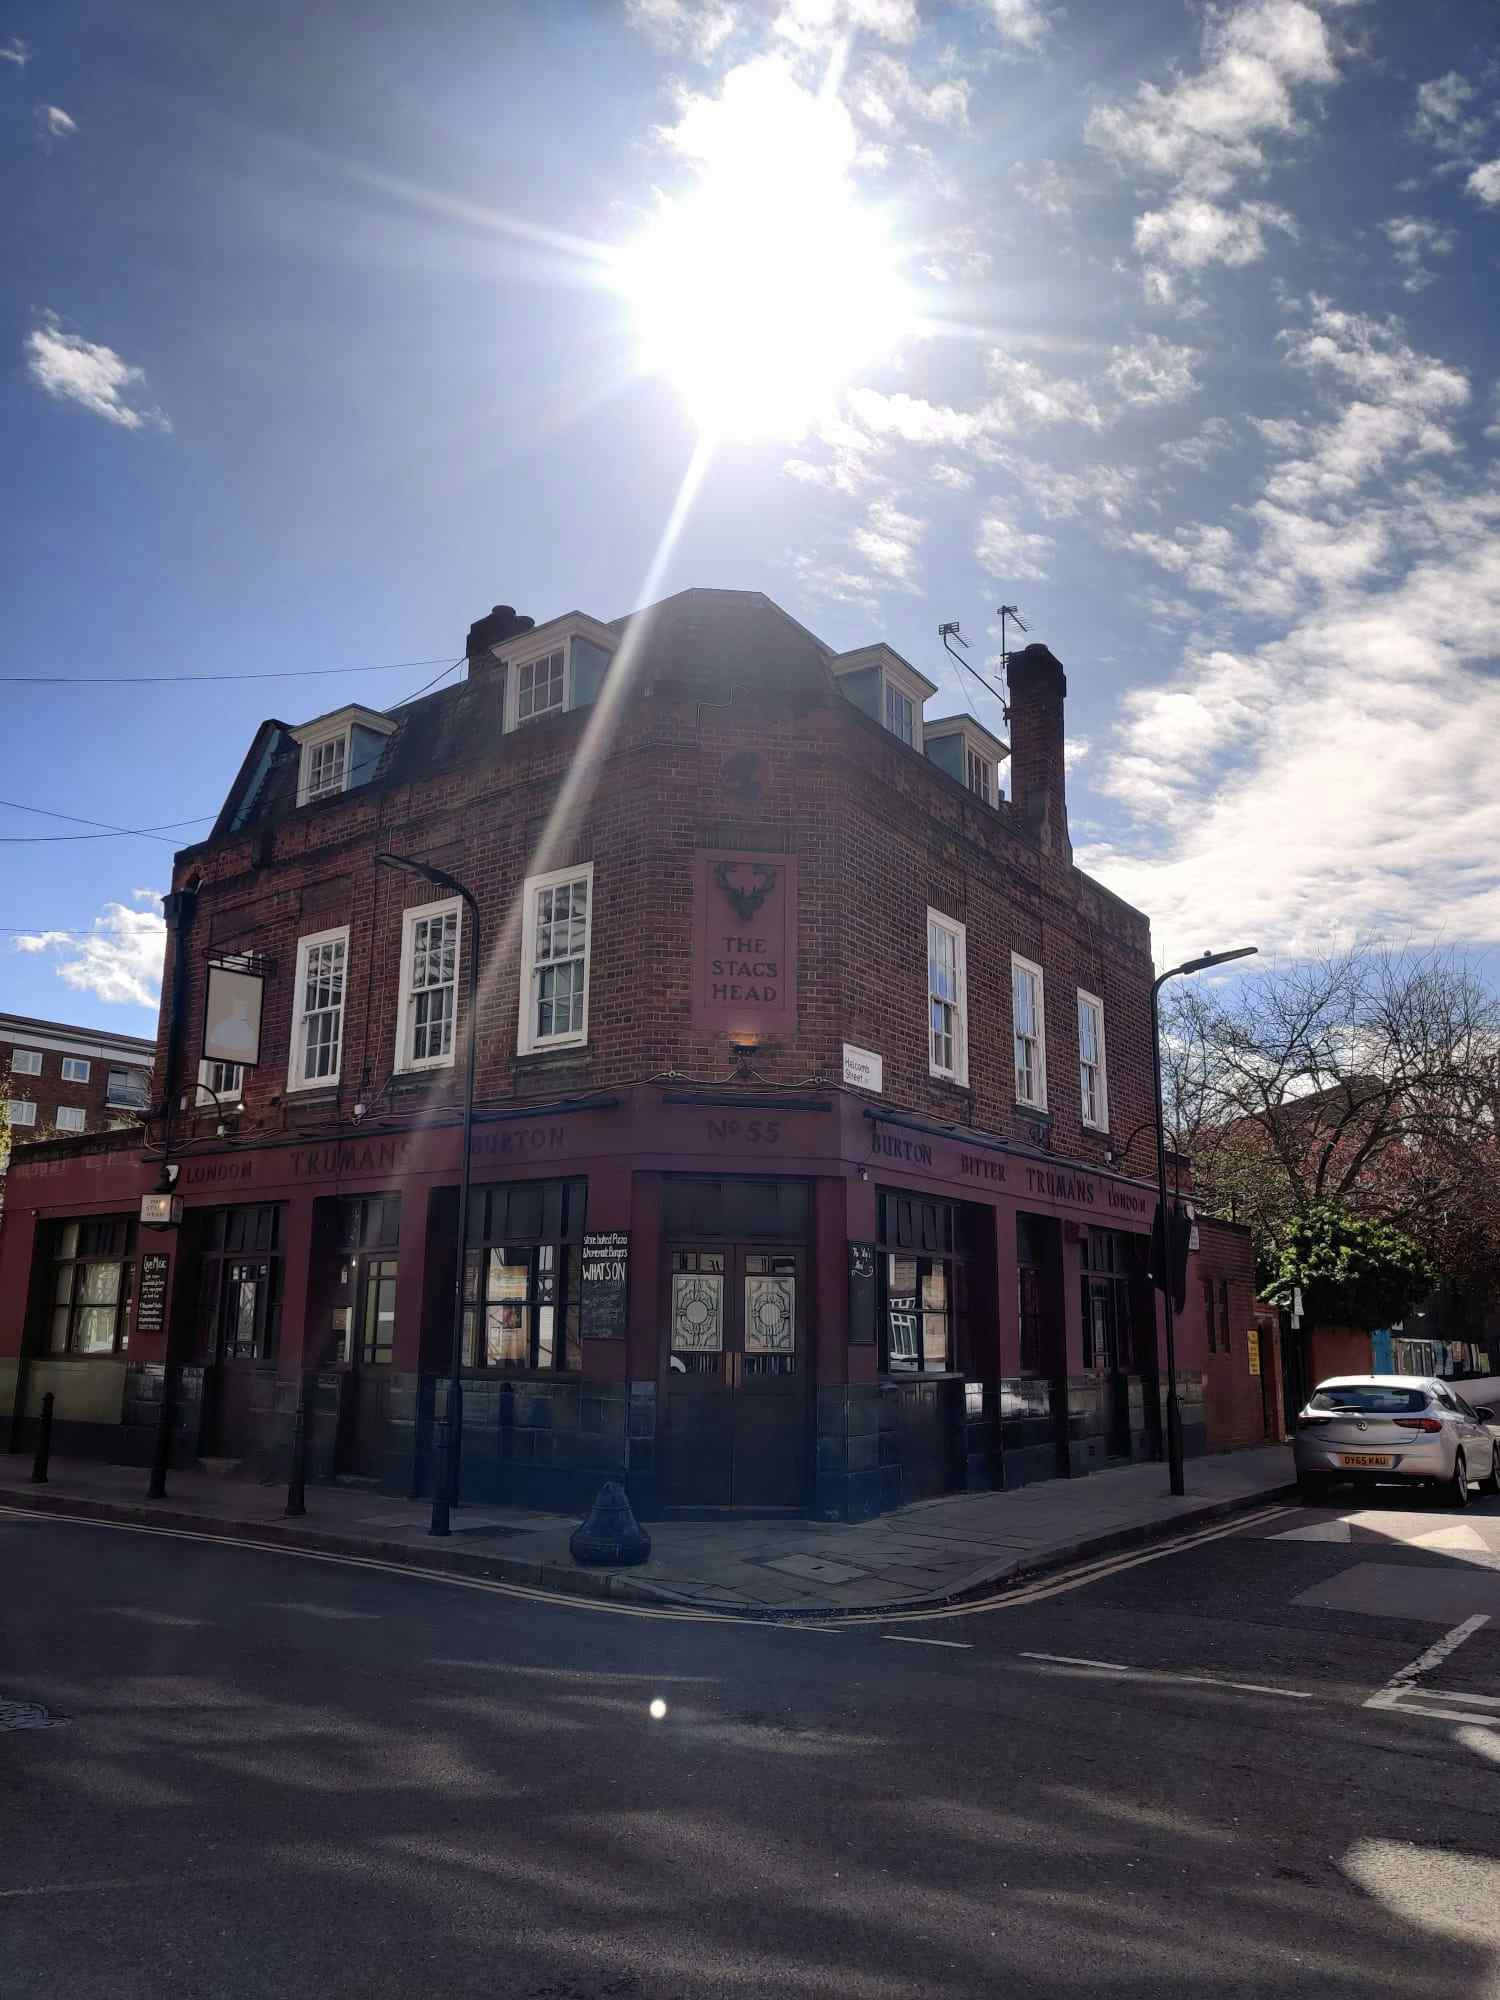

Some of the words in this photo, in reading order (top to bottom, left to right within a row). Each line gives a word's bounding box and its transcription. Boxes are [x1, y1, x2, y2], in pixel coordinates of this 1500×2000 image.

[721, 936, 767, 954] THE
[711, 960, 778, 978] STAGS
[711, 983, 777, 1002] HEAD
[845, 1068, 863, 1084] Street
[744, 1120, 780, 1144] 55
[872, 1131, 932, 1167] BURTON
[961, 1152, 1007, 1182] BITTER
[184, 1159, 253, 1185] LONDON
[611, 1261, 626, 1281] ON
